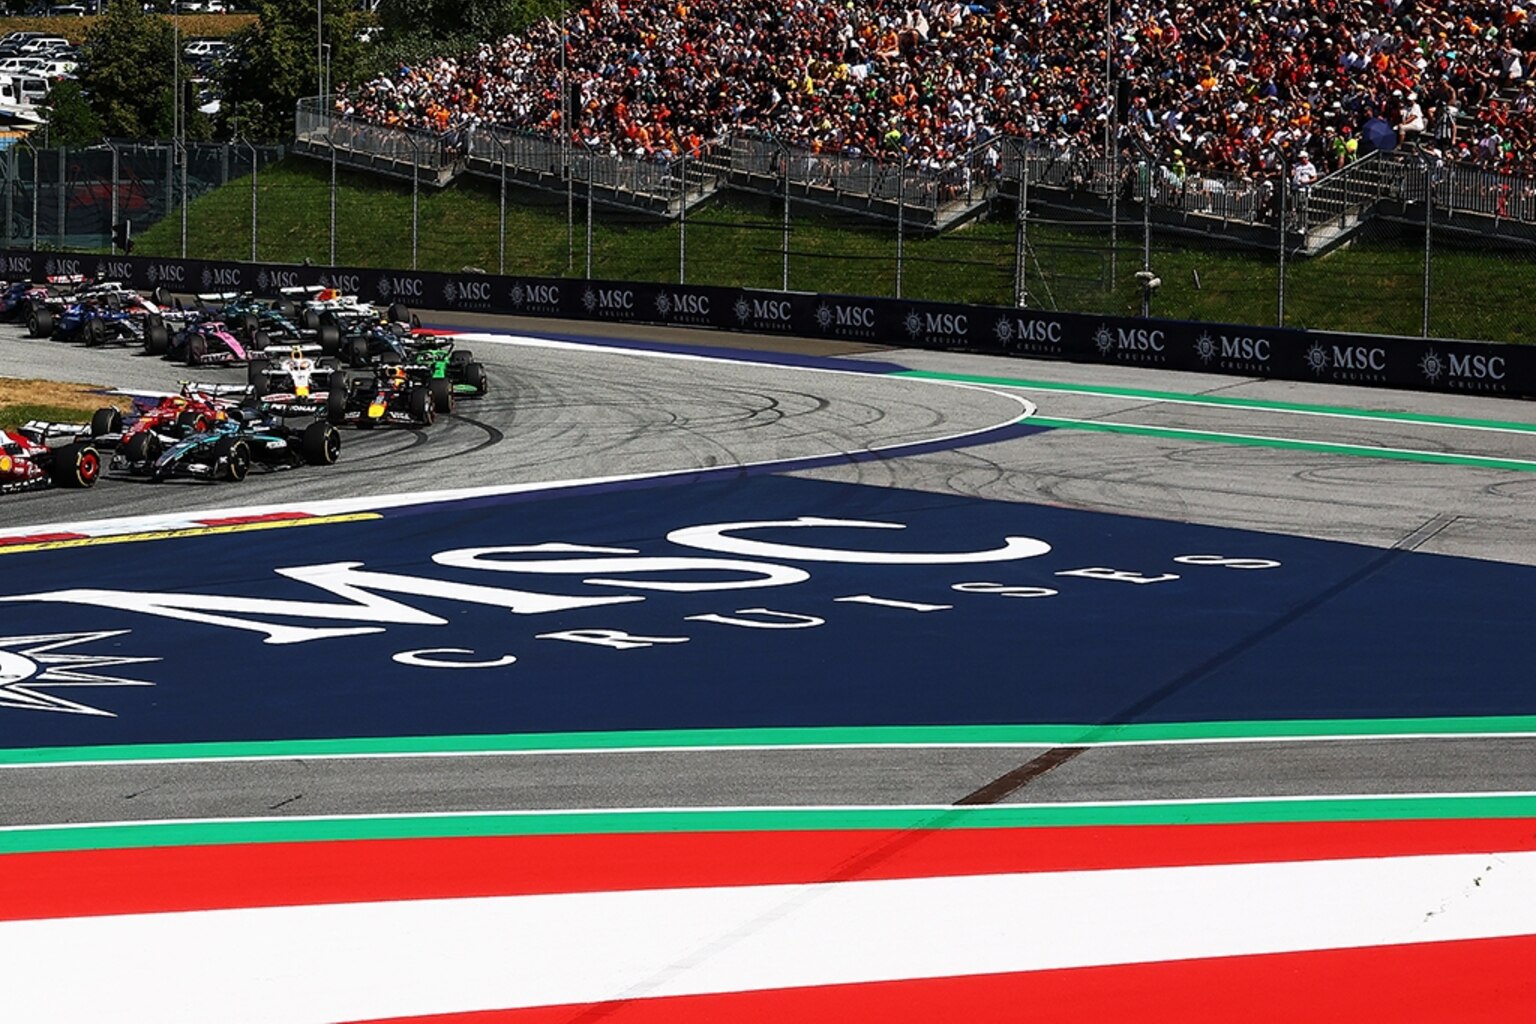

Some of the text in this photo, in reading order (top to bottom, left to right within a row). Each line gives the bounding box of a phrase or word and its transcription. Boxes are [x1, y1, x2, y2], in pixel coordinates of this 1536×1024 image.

[8, 257, 32, 272] MSC
[56, 260, 80, 274] MSC
[108, 262, 132, 278] MSC
[159, 265, 184, 281] MSC
[215, 268, 241, 285] MSC
[270, 271, 298, 287] MSC
[332, 275, 359, 292] MSC
[393, 279, 422, 296] MSC
[459, 282, 490, 300] MSC
[527, 285, 559, 304] MSC
[600, 289, 633, 309] MSC
[673, 294, 710, 314] MSC
[753, 299, 791, 320] MSC
[835, 305, 874, 327] MSC
[926, 312, 968, 335] MSC
[1017, 319, 1061, 342] MSC
[1117, 328, 1164, 352] MSC
[1220, 336, 1270, 360] MSC
[1221, 361, 1271, 372] CRUISES
[1333, 345, 1385, 371] MSC
[1448, 353, 1505, 379] MSC
[1333, 371, 1386, 381] CRUISES
[1449, 380, 1506, 391] CRUISES
[393, 553, 1281, 668] CRUISES
